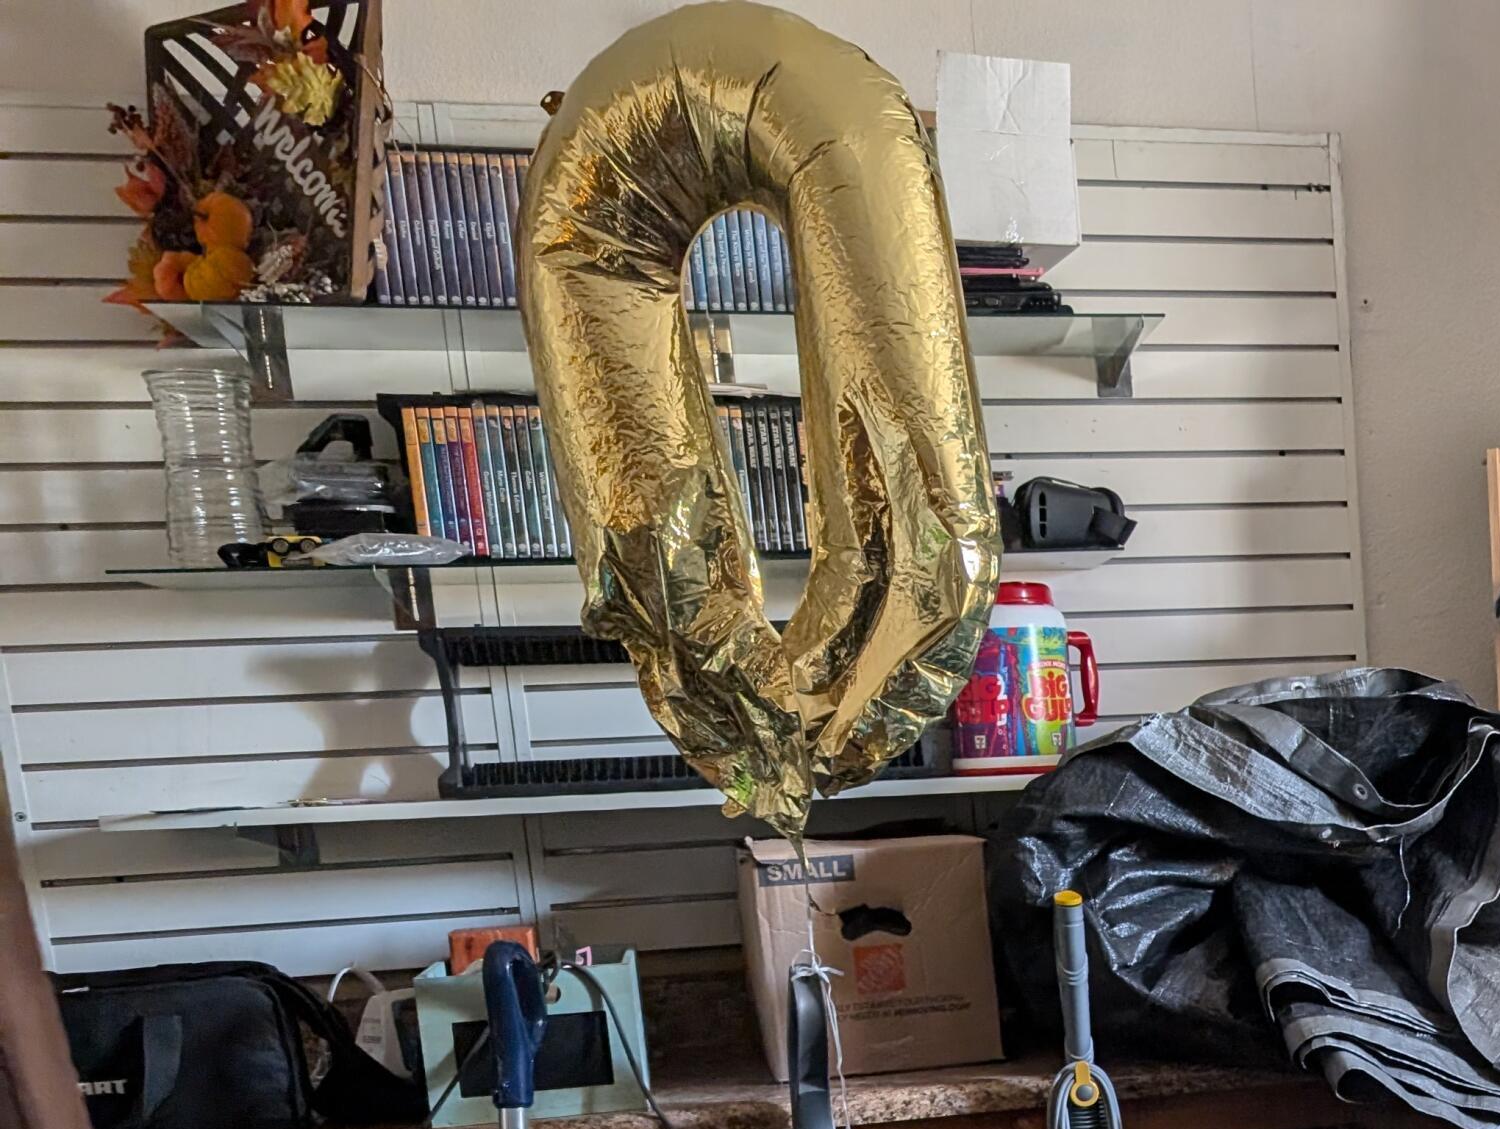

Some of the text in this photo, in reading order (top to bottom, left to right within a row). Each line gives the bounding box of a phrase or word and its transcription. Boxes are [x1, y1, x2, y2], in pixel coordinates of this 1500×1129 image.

[745, 421, 757, 469] STAR WARS
[758, 421, 770, 468] STAR WARS
[771, 422, 782, 470] STAR WARS
[784, 421, 797, 468] STAR WARS
[767, 858, 848, 882] SMALL
[77, 1078, 129, 1096] ART
